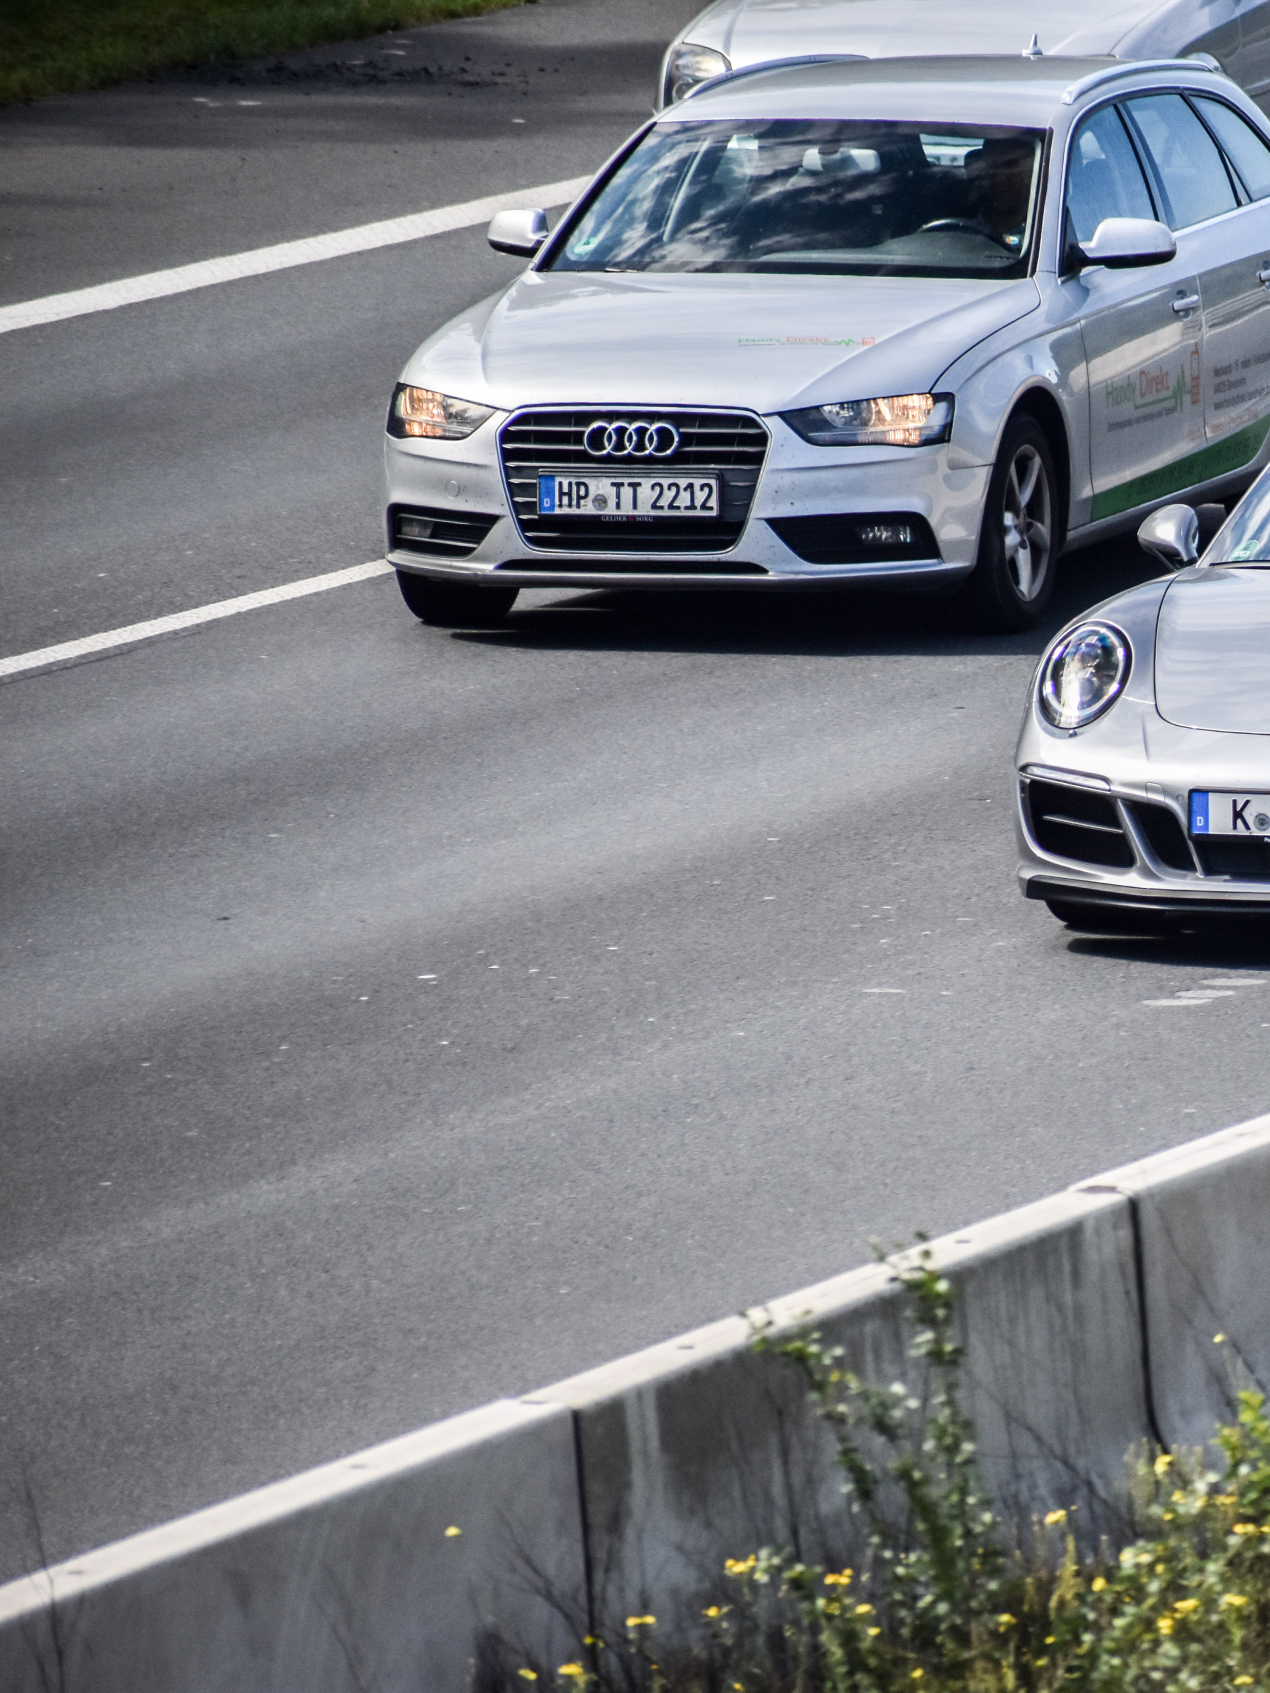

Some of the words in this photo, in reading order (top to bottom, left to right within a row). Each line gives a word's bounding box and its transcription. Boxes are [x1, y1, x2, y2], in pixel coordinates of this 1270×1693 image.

[1105, 375, 1137, 408] Handy
[1139, 365, 1170, 398] Direkt
[543, 498, 550, 507] D
[557, 481, 590, 509] HP
[610, 481, 642, 510] TT
[650, 482, 714, 511] 2212
[1196, 816, 1204, 827] D
[1232, 798, 1251, 831] K
